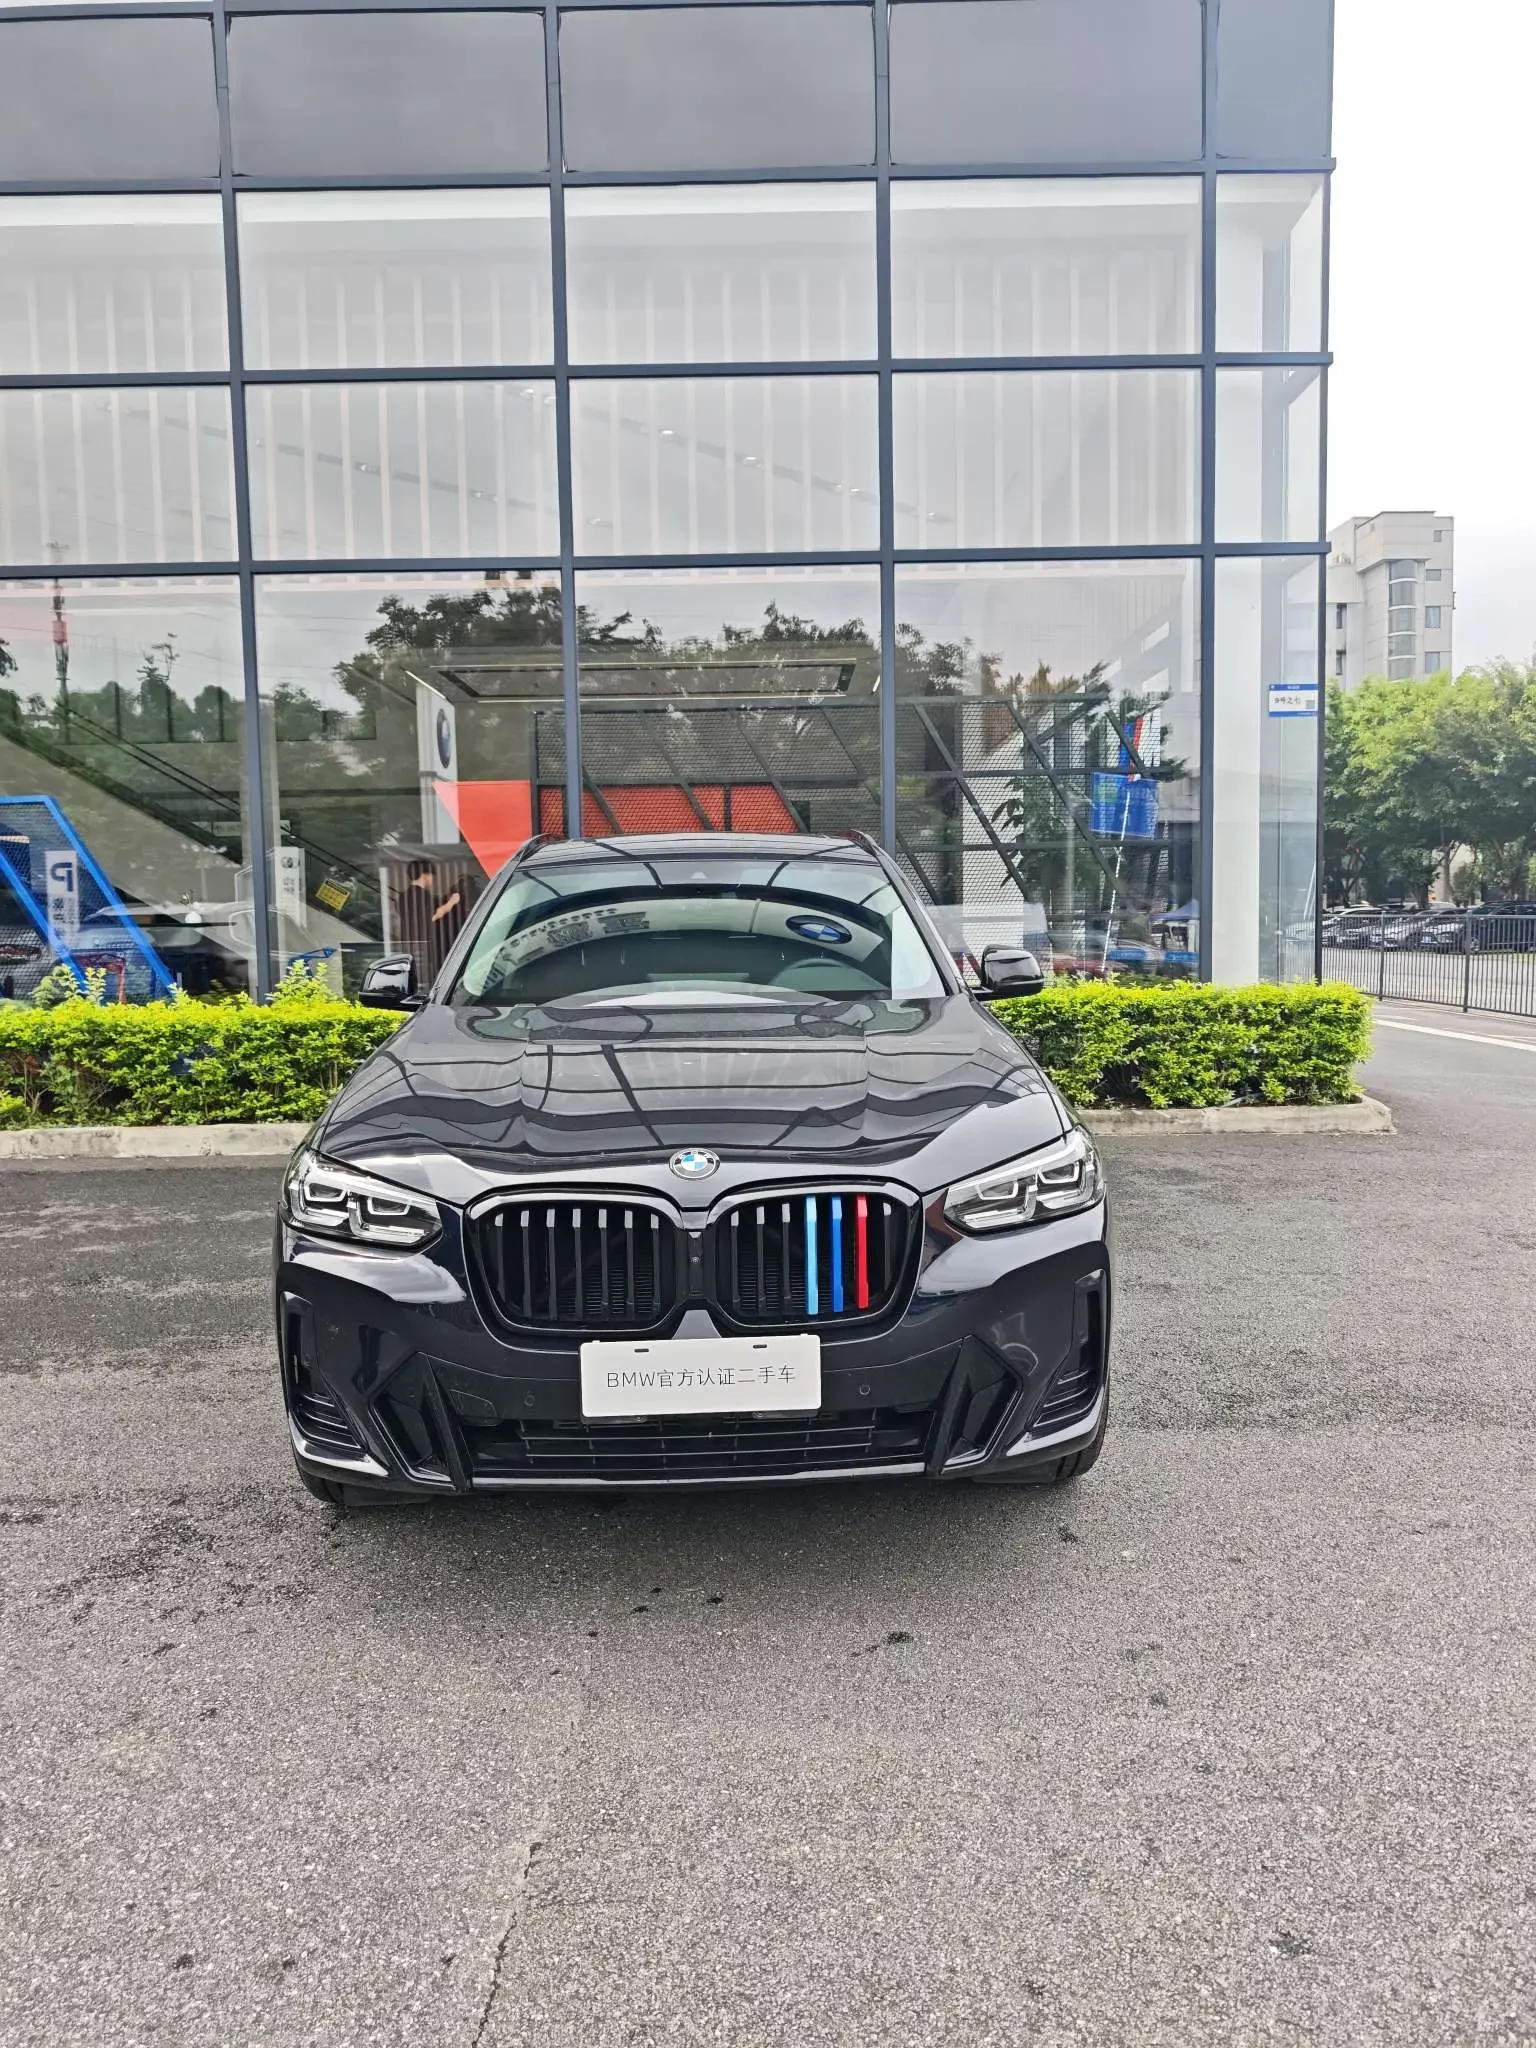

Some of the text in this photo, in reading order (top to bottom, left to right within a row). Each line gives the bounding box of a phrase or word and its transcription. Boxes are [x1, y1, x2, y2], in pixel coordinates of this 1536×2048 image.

[607, 1364, 796, 1388] BMW官方认证二手车
